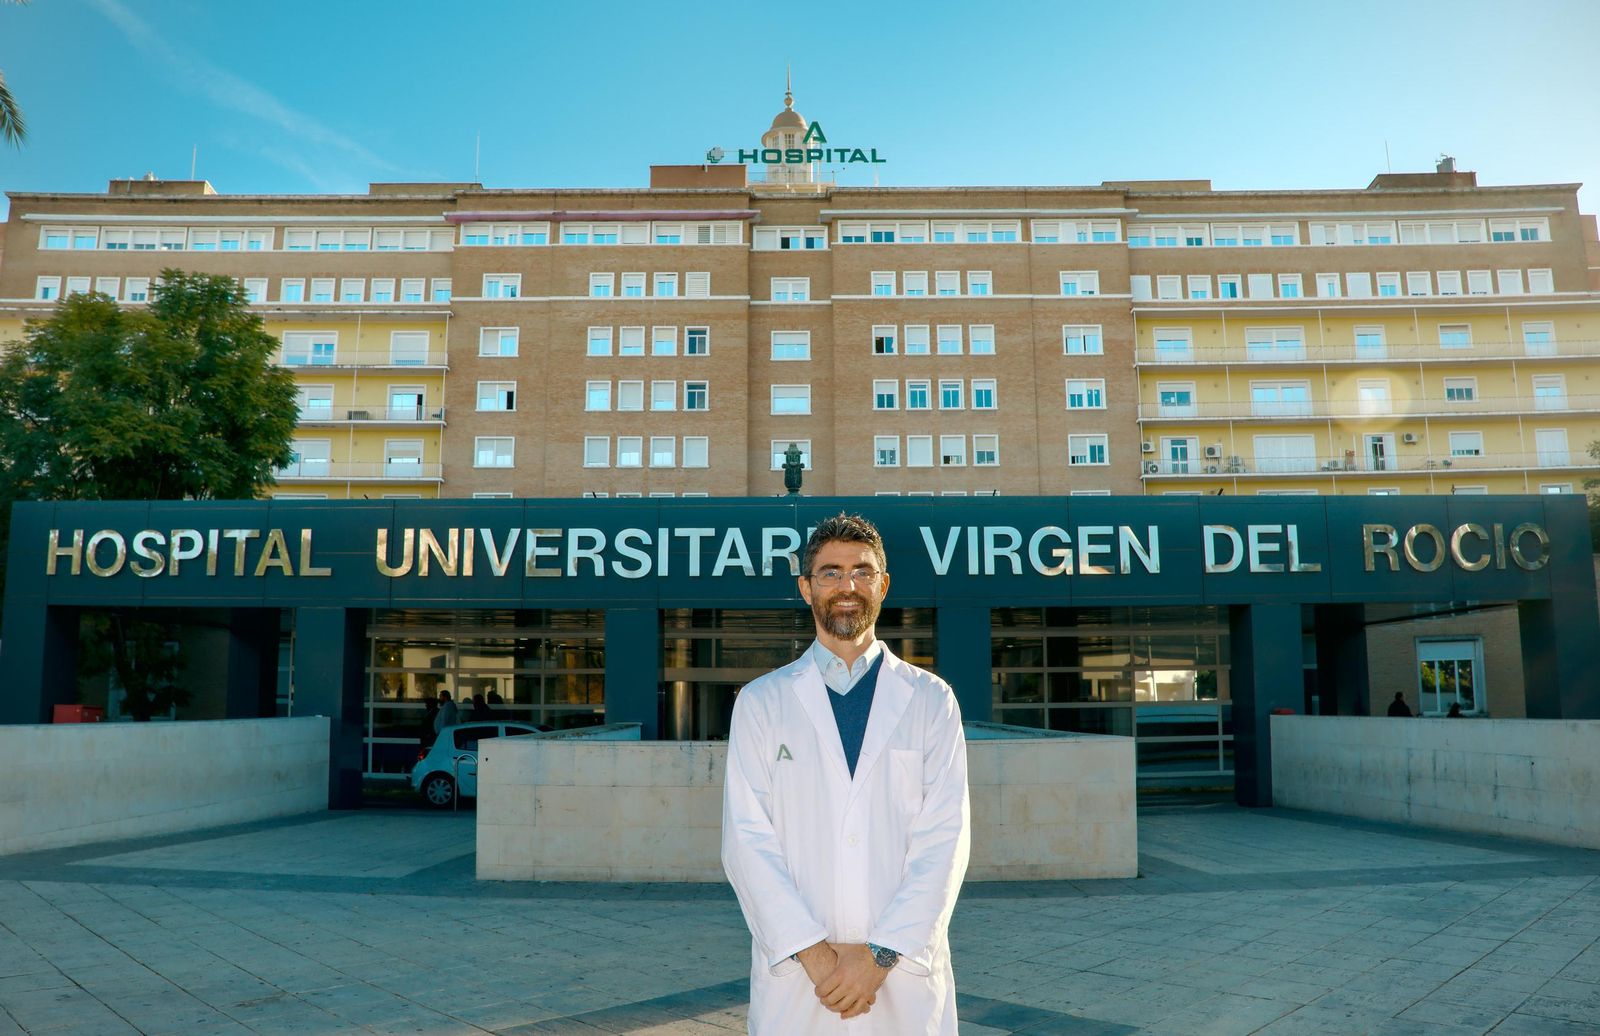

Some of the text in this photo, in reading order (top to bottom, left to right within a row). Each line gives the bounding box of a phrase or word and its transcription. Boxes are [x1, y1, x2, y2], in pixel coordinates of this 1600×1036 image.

[738, 148, 887, 163] HOSPITAL
[46, 529, 332, 577] HOSPITAL
[375, 527, 818, 578] UNIVERSITAR
[919, 525, 1160, 576] VIRGEN
[1203, 524, 1322, 573] DEL
